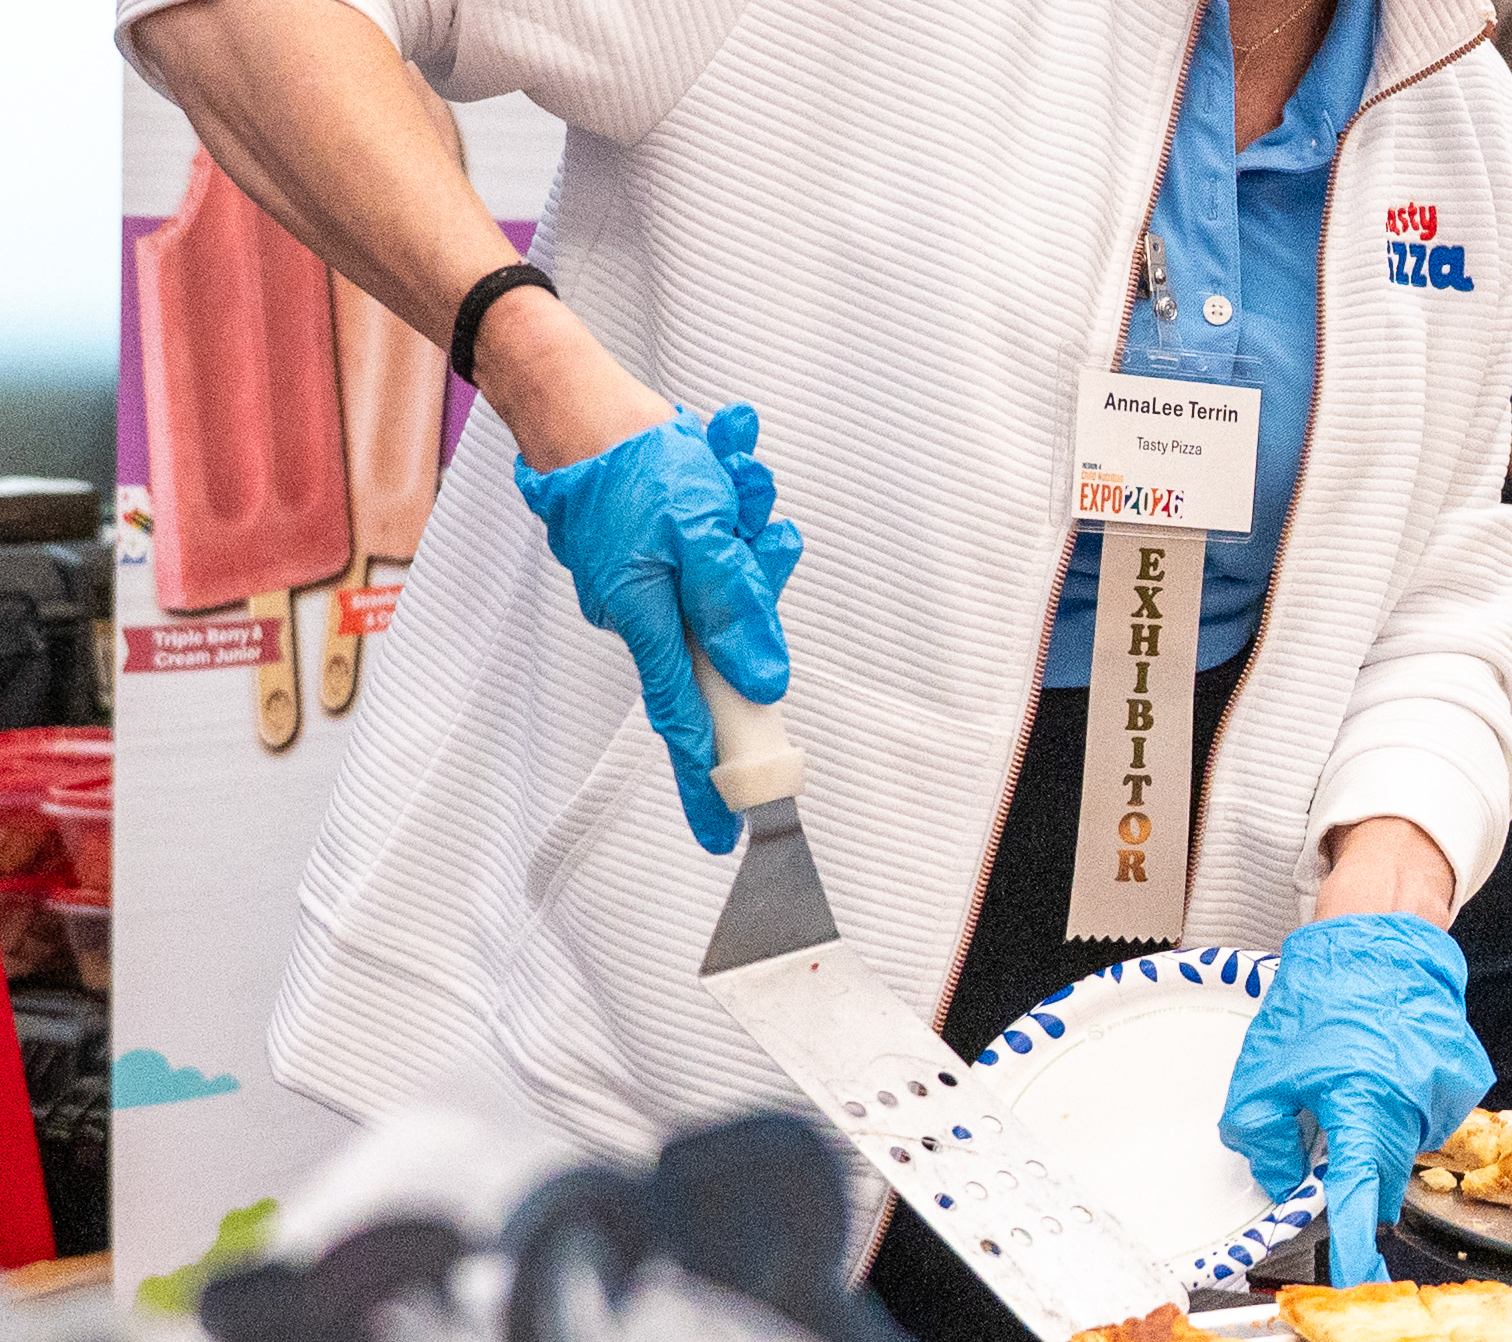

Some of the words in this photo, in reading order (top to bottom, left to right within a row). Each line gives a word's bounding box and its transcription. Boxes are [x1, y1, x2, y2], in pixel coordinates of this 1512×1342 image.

[1104, 392, 1184, 417] AnnaLee
[1189, 401, 1239, 422] Terrin
[1137, 436, 1168, 455] Tasty
[1171, 440, 1202, 455] Pizza
[153, 629, 206, 649] Triple
[154, 649, 210, 668] Cream
[215, 646, 263, 665] Junior
[1114, 546, 1168, 885] EXHIBITOR
